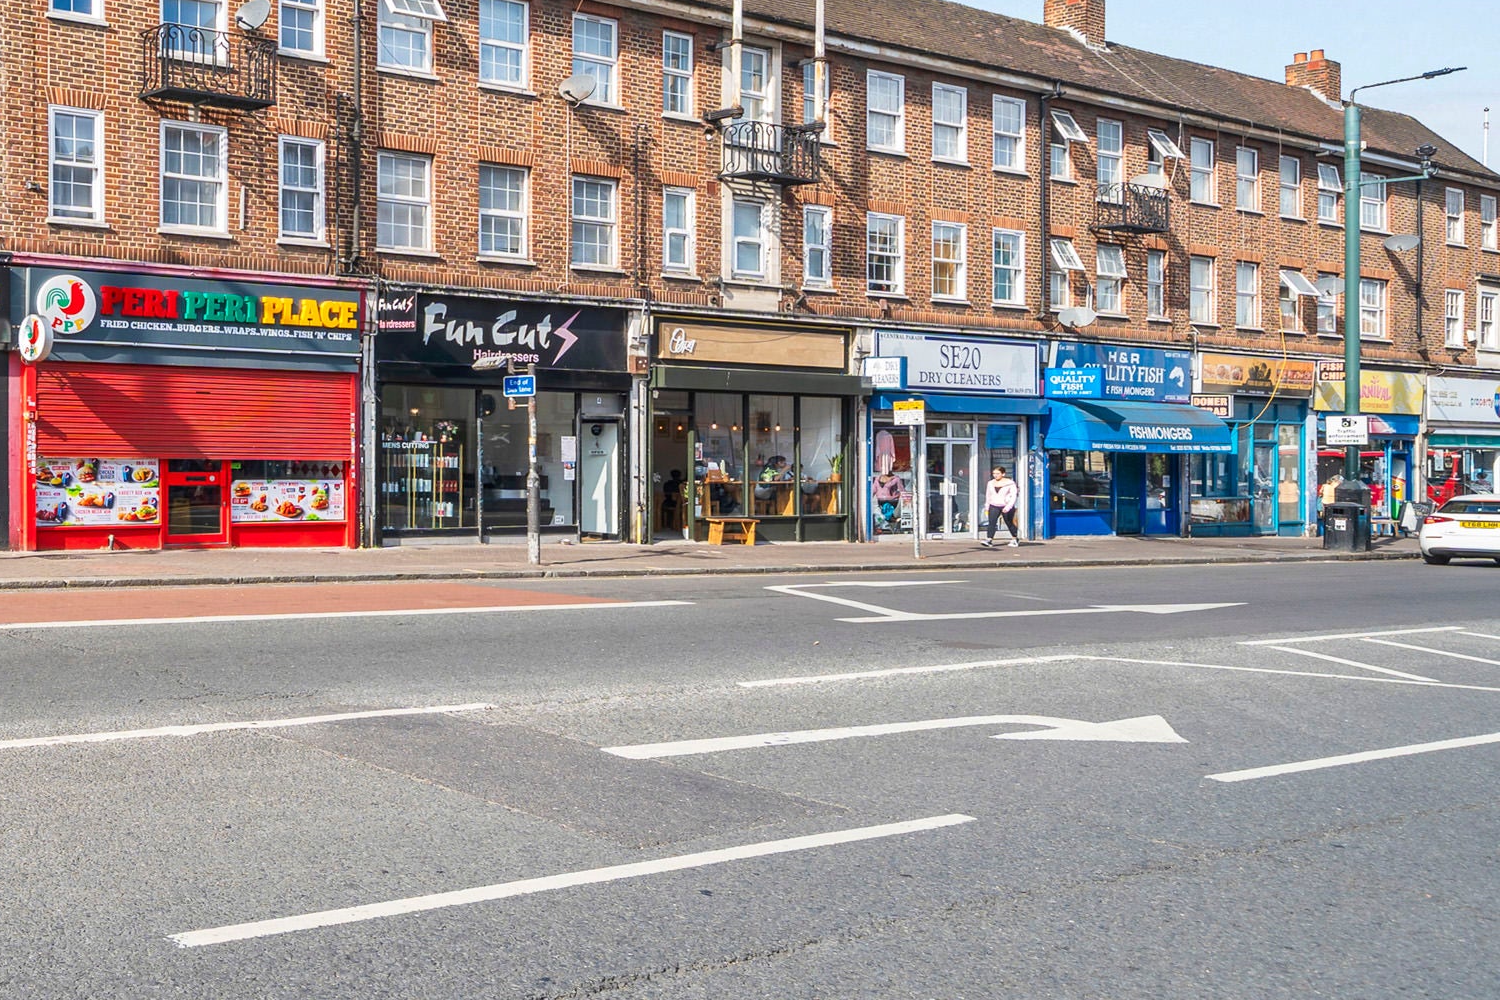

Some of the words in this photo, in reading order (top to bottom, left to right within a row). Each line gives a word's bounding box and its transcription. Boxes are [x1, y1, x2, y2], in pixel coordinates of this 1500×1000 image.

[99, 285, 179, 319] PERI
[261, 296, 358, 329] PLACE
[52, 317, 85, 332] PPP
[100, 319, 129, 329] FRIED
[327, 332, 353, 341] CHIPS
[422, 302, 484, 346] Fun
[940, 344, 982, 370] SE20
[1108, 351, 1117, 362] H
[1119, 352, 1128, 363] &
[1131, 353, 1140, 364] R
[1137, 366, 1164, 383] FISH
[1320, 362, 1344, 371] FISH
[919, 371, 943, 384] DRY
[945, 373, 1002, 387] CLEANERS
[1050, 375, 1095, 385] QUALITY
[1061, 383, 1084, 391] FISH
[1111, 386, 1123, 394] FISH
[1124, 387, 1155, 397] MONGERS
[1129, 425, 1193, 441] FISHMONGERS
